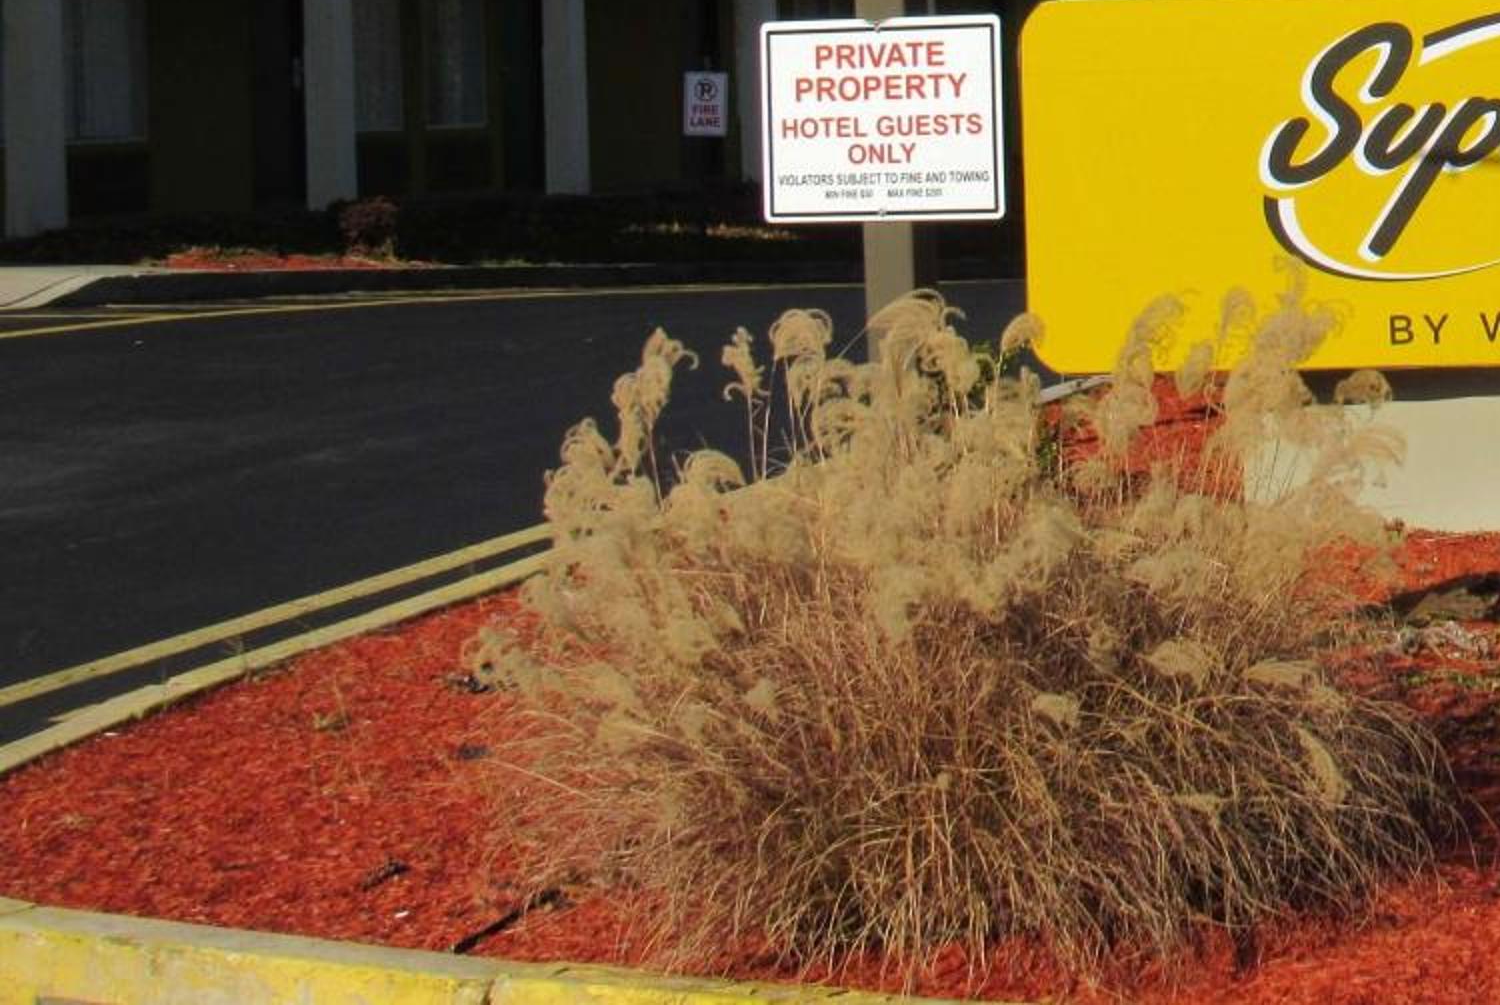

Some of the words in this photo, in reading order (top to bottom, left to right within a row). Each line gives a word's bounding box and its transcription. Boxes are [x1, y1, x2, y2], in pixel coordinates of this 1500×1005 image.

[815, 42, 945, 69] PRIVATE
[795, 73, 967, 102] PROPERTY
[690, 117, 720, 127] LANE
[782, 117, 868, 139] HOTEL
[876, 113, 983, 137] GUESTS
[848, 143, 916, 164] ONLY
[779, 174, 834, 186] VIOLATORS
[837, 173, 881, 185] SUBJECT
[884, 172, 898, 184] TO
[900, 172, 922, 183] FINE
[925, 171, 947, 183] AND
[950, 170, 990, 182] TOWING
[1389, 314, 1446, 345] BY
